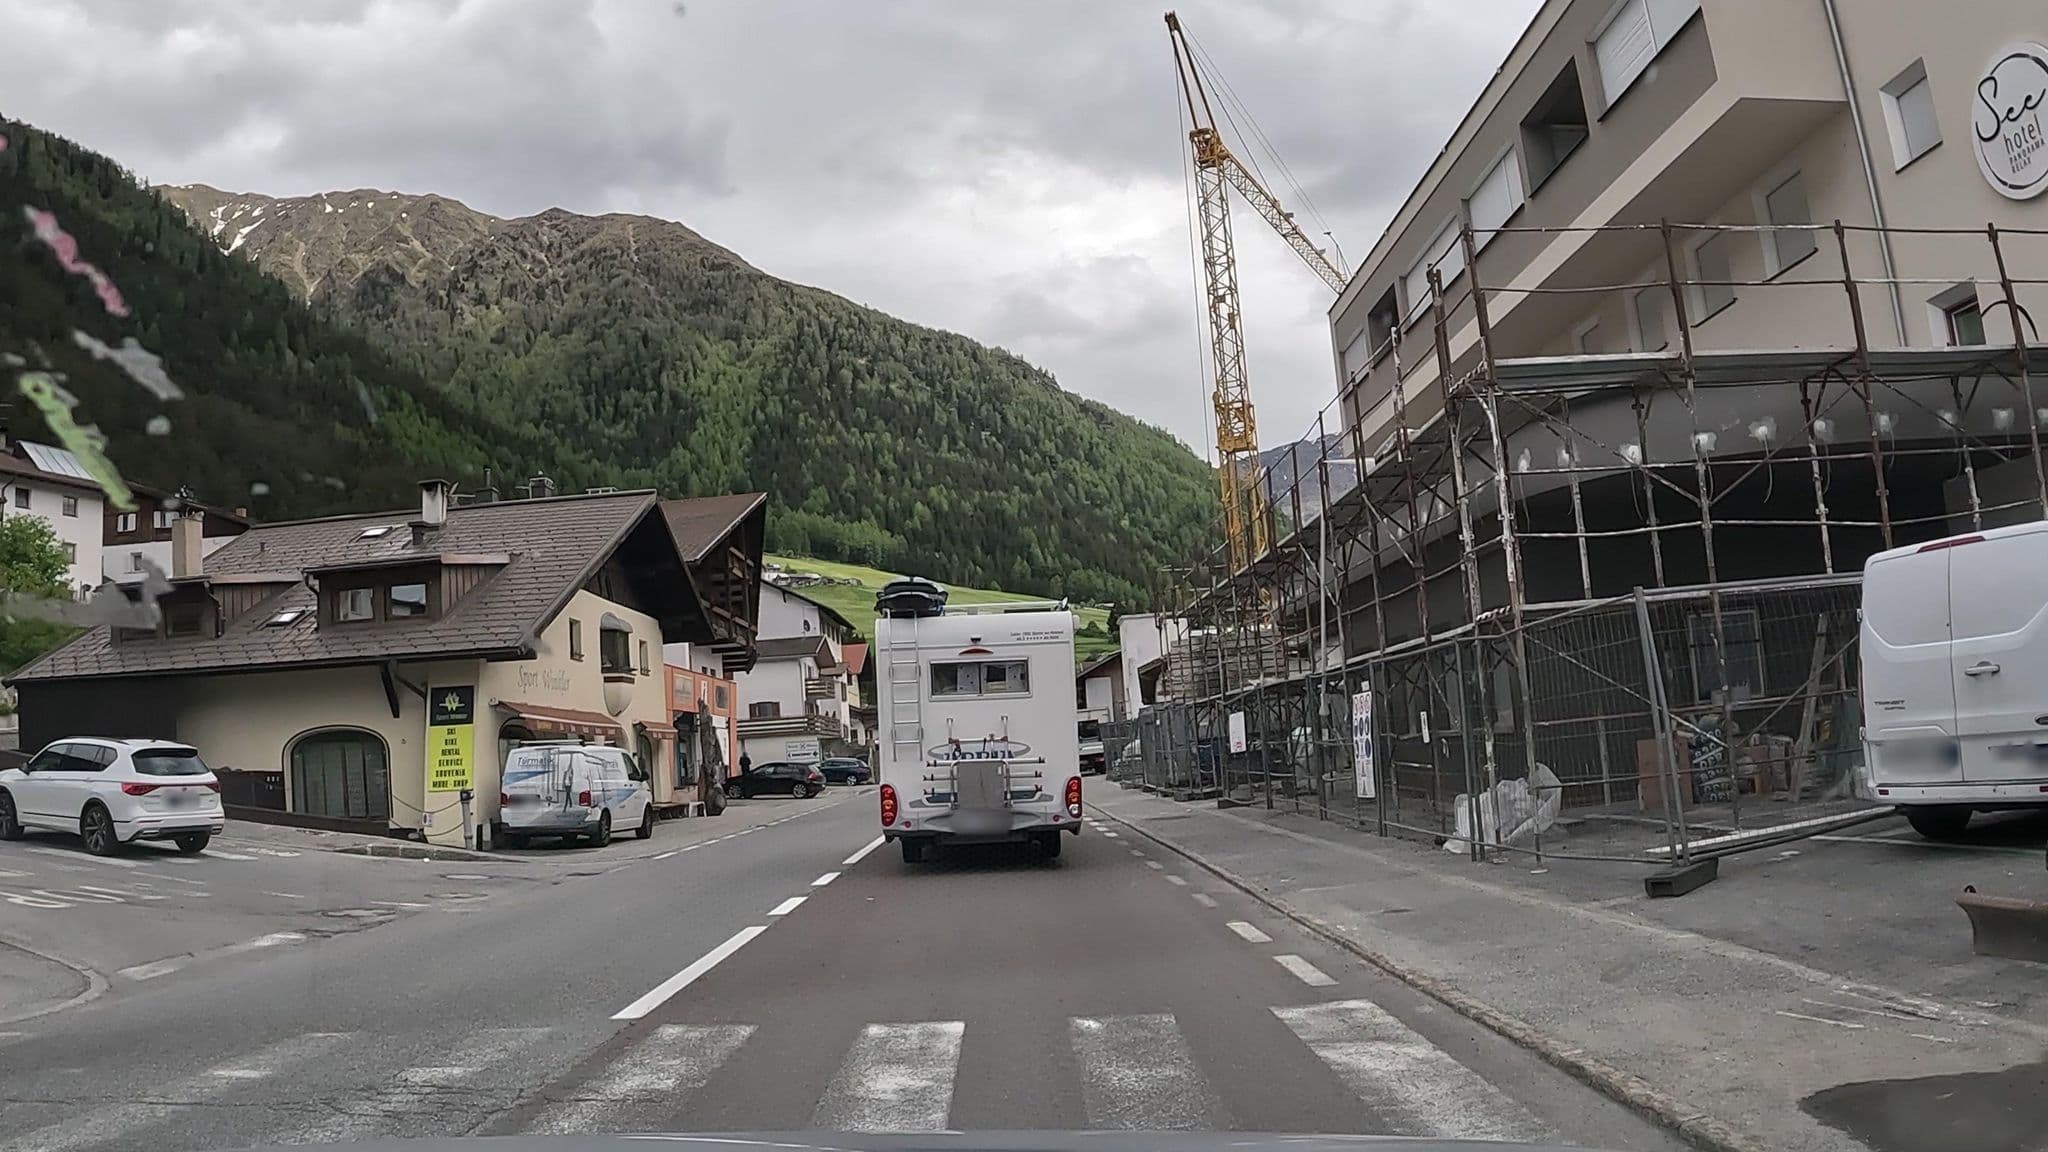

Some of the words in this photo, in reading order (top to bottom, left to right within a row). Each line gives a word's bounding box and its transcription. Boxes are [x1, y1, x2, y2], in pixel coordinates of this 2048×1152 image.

[1975, 75, 2047, 142] See
[2003, 113, 2042, 155] hotel
[2009, 138, 2046, 165] PANORAMA
[2012, 156, 2032, 174] RELAX
[446, 728, 457, 736] SKI
[444, 738, 458, 746] BIKE
[441, 748, 461, 757] RENTAL
[438, 758, 463, 767] SERVICE
[435, 768, 466, 778] SOUVENIR
